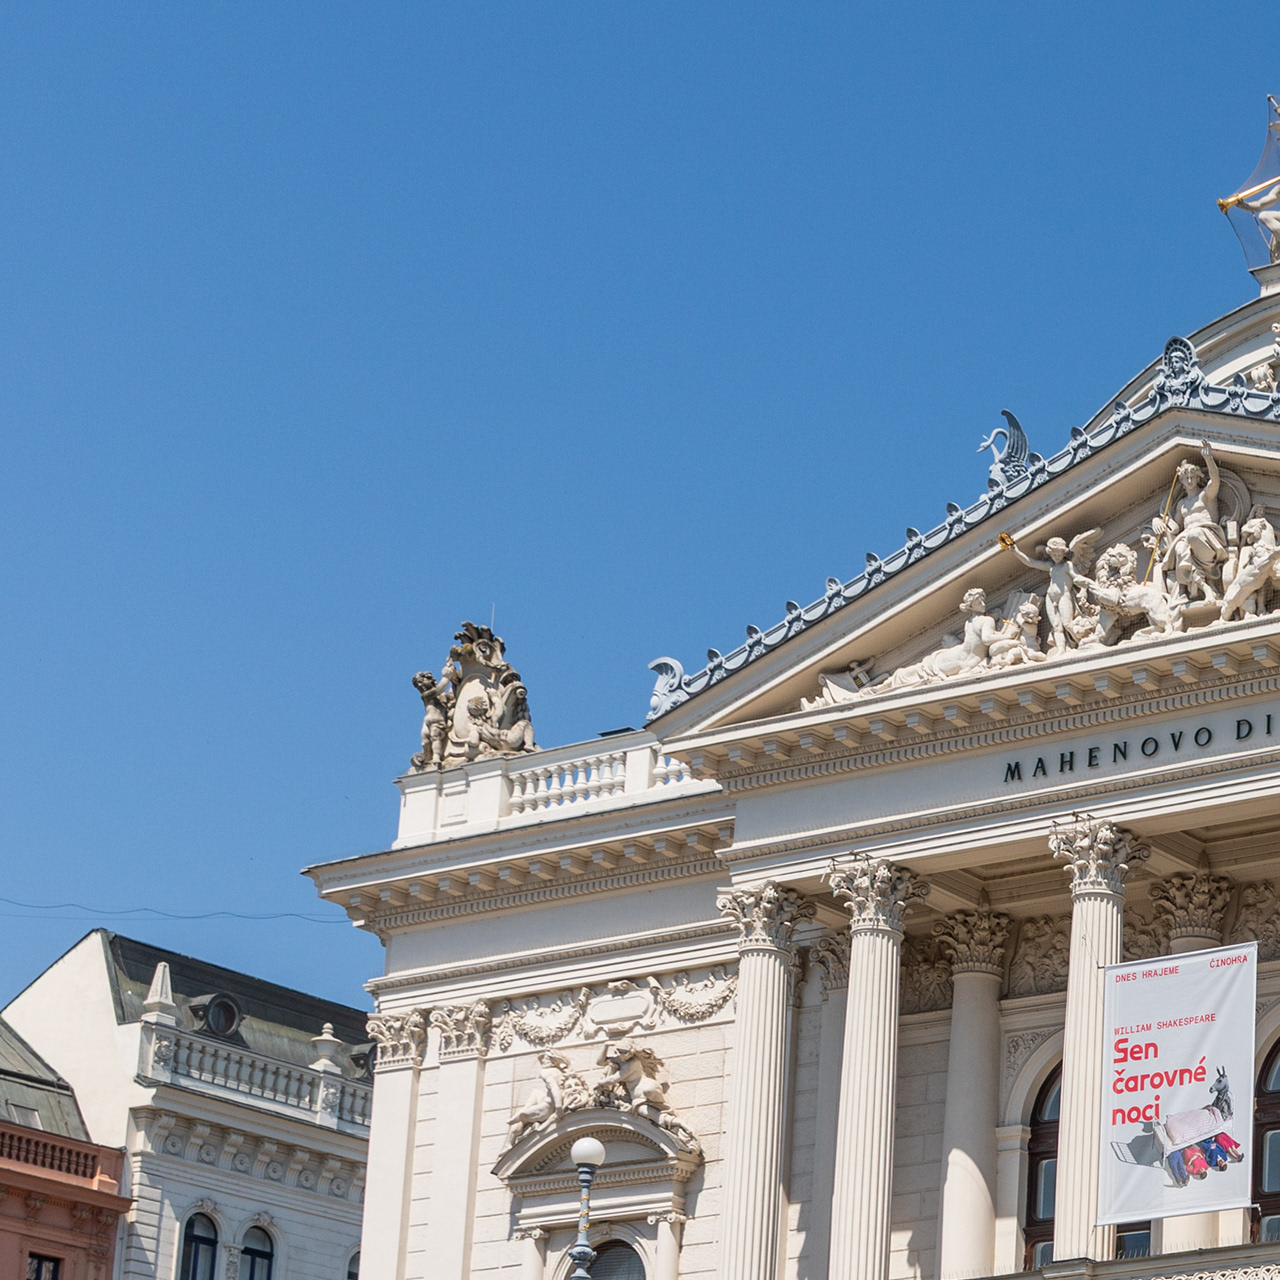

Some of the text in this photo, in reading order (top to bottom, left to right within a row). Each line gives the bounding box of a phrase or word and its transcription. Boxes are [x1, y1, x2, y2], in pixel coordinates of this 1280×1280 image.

[1003, 726, 1213, 783] MAHENOVO
[1115, 965, 1180, 983] DNES HRAJEME
[1209, 954, 1248, 969] ČINOHRA
[1114, 1012, 1217, 1036] WILLIAM SHAKESPEARE
[1113, 1038, 1159, 1064] Sen
[1112, 1055, 1207, 1095] čarovné
[1112, 1095, 1160, 1126] noci
